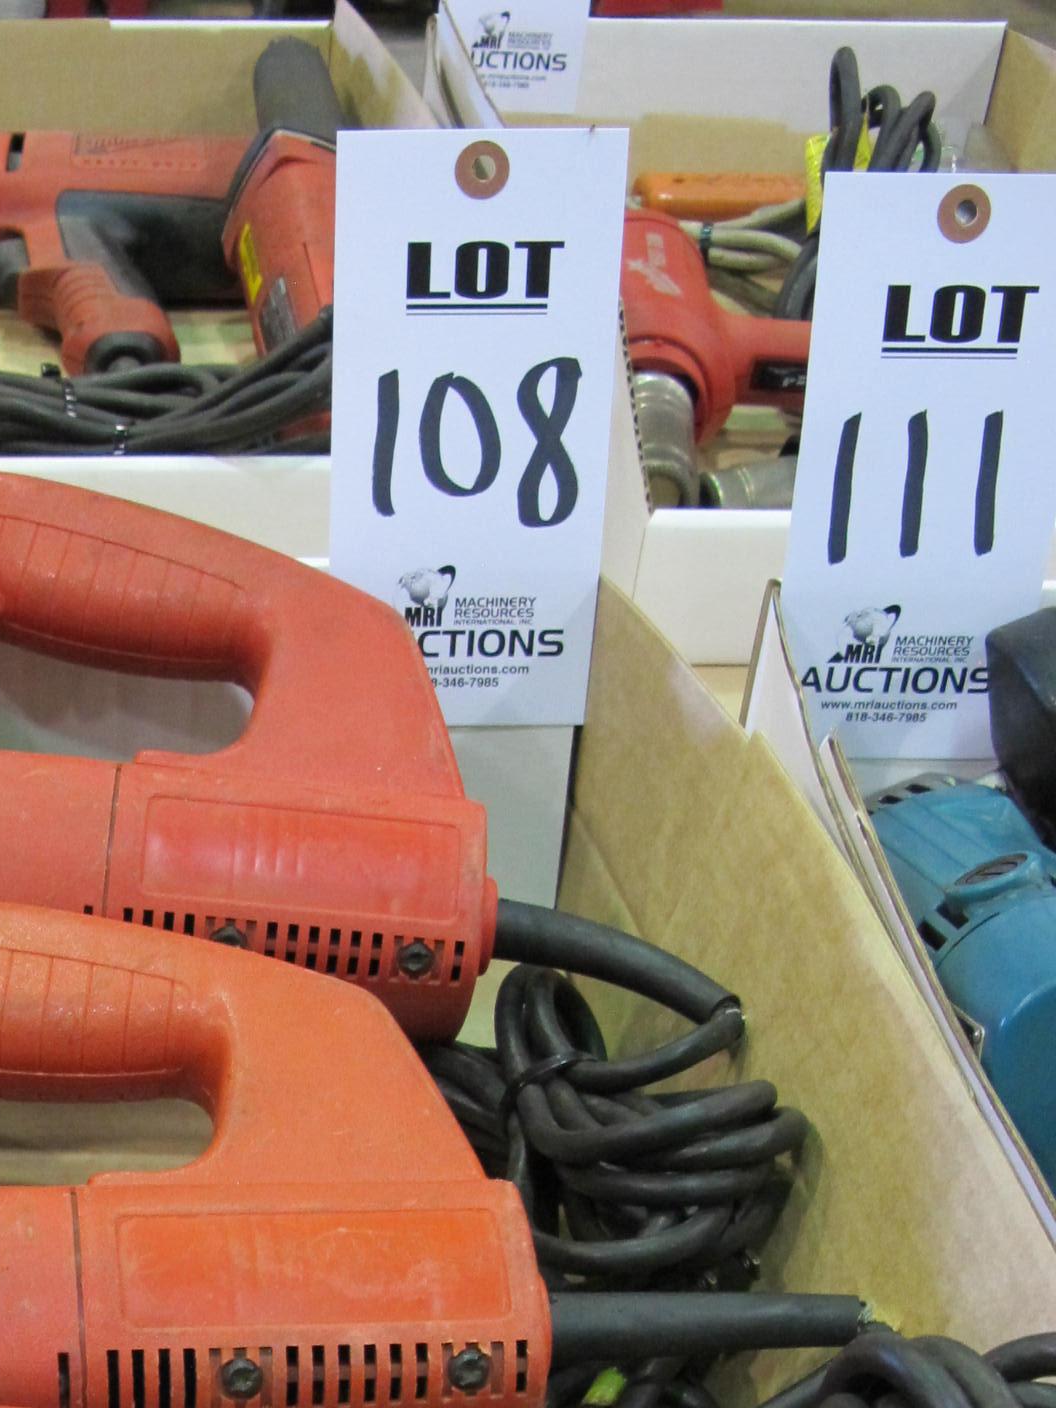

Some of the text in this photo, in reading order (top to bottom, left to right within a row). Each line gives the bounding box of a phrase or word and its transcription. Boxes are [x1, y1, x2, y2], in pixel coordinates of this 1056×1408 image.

[406, 240, 565, 300] LOT
[882, 285, 1040, 343] LOT
[371, 357, 583, 528] 108
[828, 410, 1003, 564] 111
[454, 608, 534, 618] RESOURCES
[455, 597, 536, 608] MACHINERY
[405, 606, 445, 627] MRI
[415, 629, 564, 657] CTIONS
[893, 646, 970, 656] RESOURCES
[895, 635, 974, 646] MACHINERY
[845, 643, 884, 664] MRI
[801, 667, 990, 693] AUCTIONS
[821, 700, 958, 711] www.mriauctions.com
[845, 712, 927, 722] 818-346-7985
